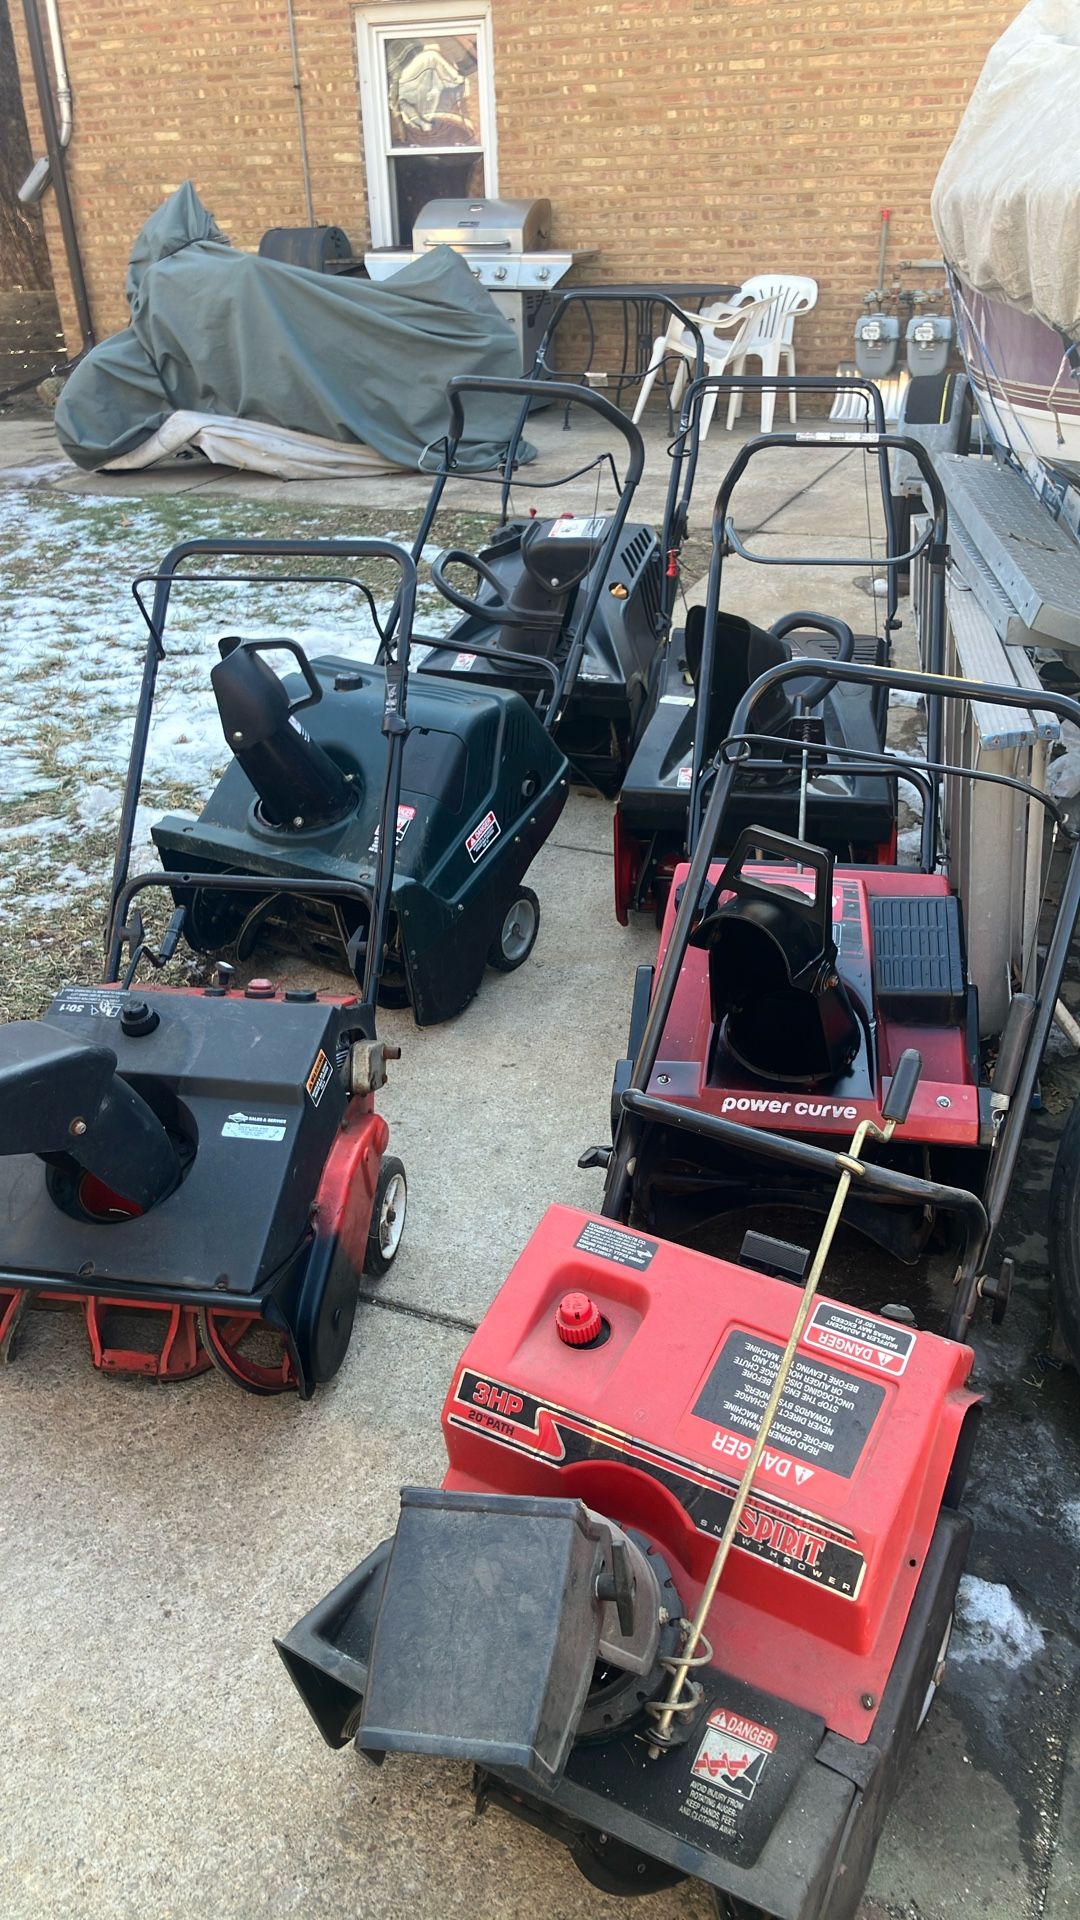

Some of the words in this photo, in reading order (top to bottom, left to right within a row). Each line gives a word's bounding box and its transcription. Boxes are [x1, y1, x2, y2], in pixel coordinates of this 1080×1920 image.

[59, 1003, 85, 1013] 50:1
[721, 1097, 791, 1114] power
[794, 1102, 857, 1119] curve
[824, 1319, 860, 1335] ADJACENT
[830, 1314, 857, 1328] EXCEED
[857, 1324, 873, 1333] MAY
[866, 1333, 898, 1349] MUFFLER
[872, 1329, 896, 1342] AREAS
[742, 1341, 779, 1361] MACHINE.
[817, 1331, 873, 1360] DANGER
[732, 1356, 760, 1372] CHUTE
[750, 1353, 766, 1365] AND
[740, 1368, 772, 1385] BEFORE
[795, 1362, 828, 1380] LEAVING
[802, 1374, 831, 1390] AUGER
[827, 1374, 859, 1393] BEFORE
[830, 1385, 843, 1395] OR
[472, 1381, 524, 1416] 3HP
[741, 1383, 794, 1409] BYSNDERS.
[800, 1391, 817, 1404] THE
[802, 1383, 855, 1409] UNCLOGGING
[816, 1398, 839, 1412] STOP
[721, 1400, 759, 1420] MACHINE.
[778, 1407, 807, 1424] DIRECT
[793, 1404, 833, 1425] TOWARDS
[727, 1412, 761, 1431] MANUAL
[806, 1418, 834, 1435] NEVER
[796, 1440, 820, 1455] READ
[802, 1432, 834, 1451] BEFORE
[764, 1505, 796, 1525] CHUTE
[802, 1522, 851, 1546] CONTROL
[736, 1506, 827, 1567] SPIRIT
[700, 1519, 851, 1591] SNWTHROWER
[726, 1716, 774, 1748] DANGER
[688, 1789, 716, 1807] ROTATING
[689, 1780, 708, 1793] AVOID
[706, 1787, 727, 1802] INJURY
[726, 1796, 744, 1810] FROM
[684, 1798, 701, 1811] KEEP
[677, 1804, 691, 1816] AND
[690, 1810, 720, 1829] CLOTHING
